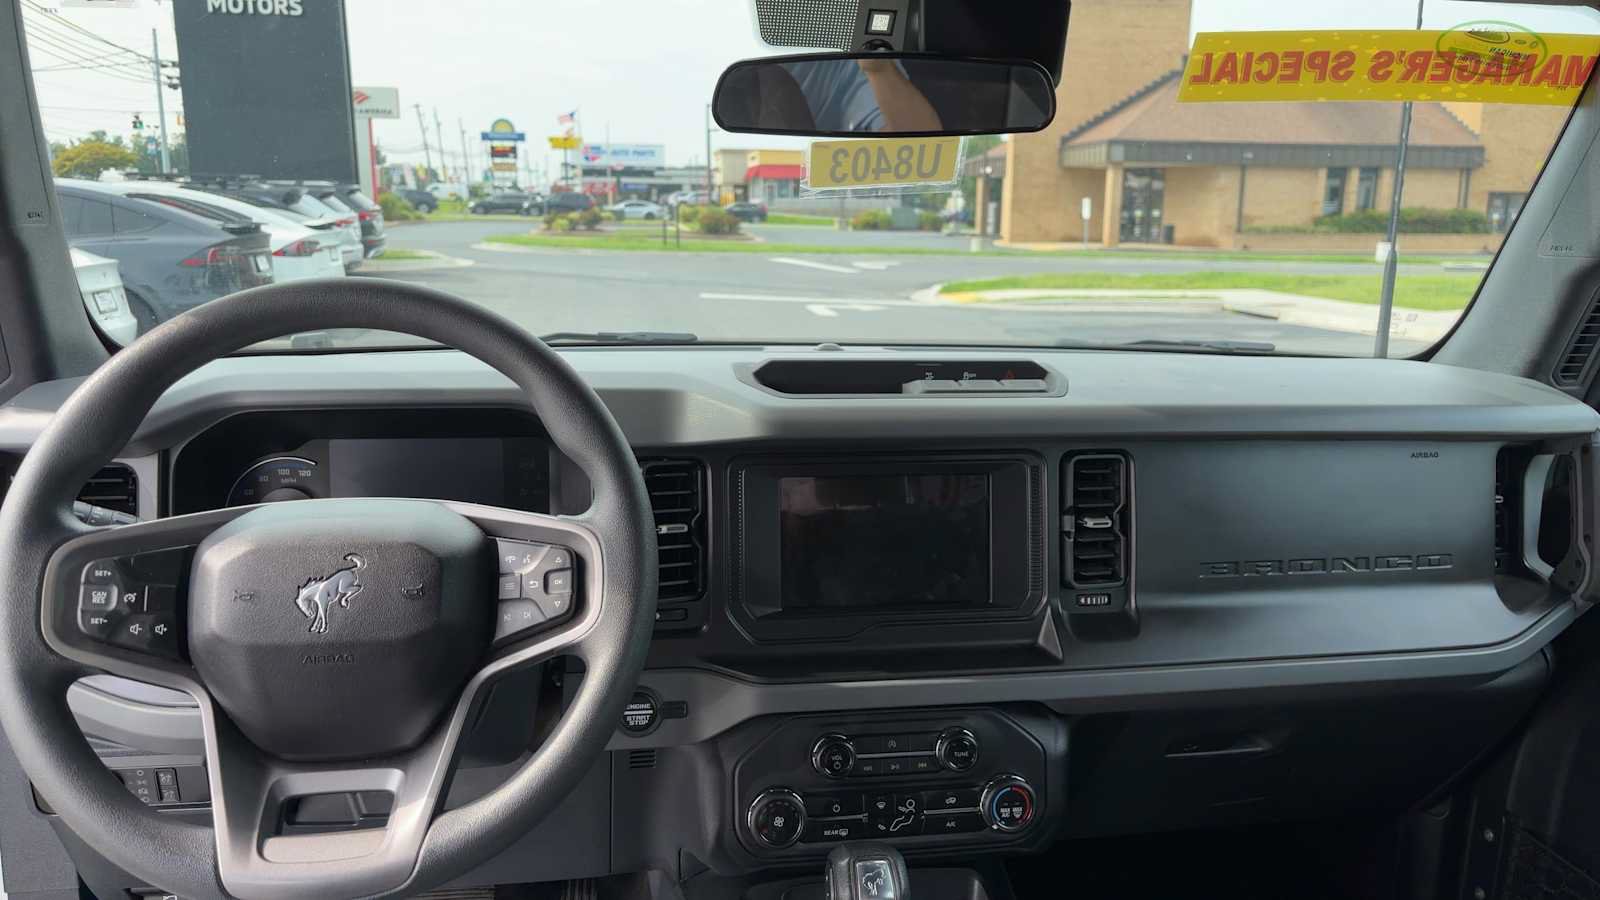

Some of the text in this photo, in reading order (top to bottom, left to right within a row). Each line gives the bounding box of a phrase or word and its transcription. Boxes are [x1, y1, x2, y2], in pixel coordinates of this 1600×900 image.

[207, 0, 304, 16] MOTORS
[1410, 451, 1439, 459] AIRBAG
[1199, 553, 1453, 579] BRONCO
[302, 653, 355, 664] AIRBAG
